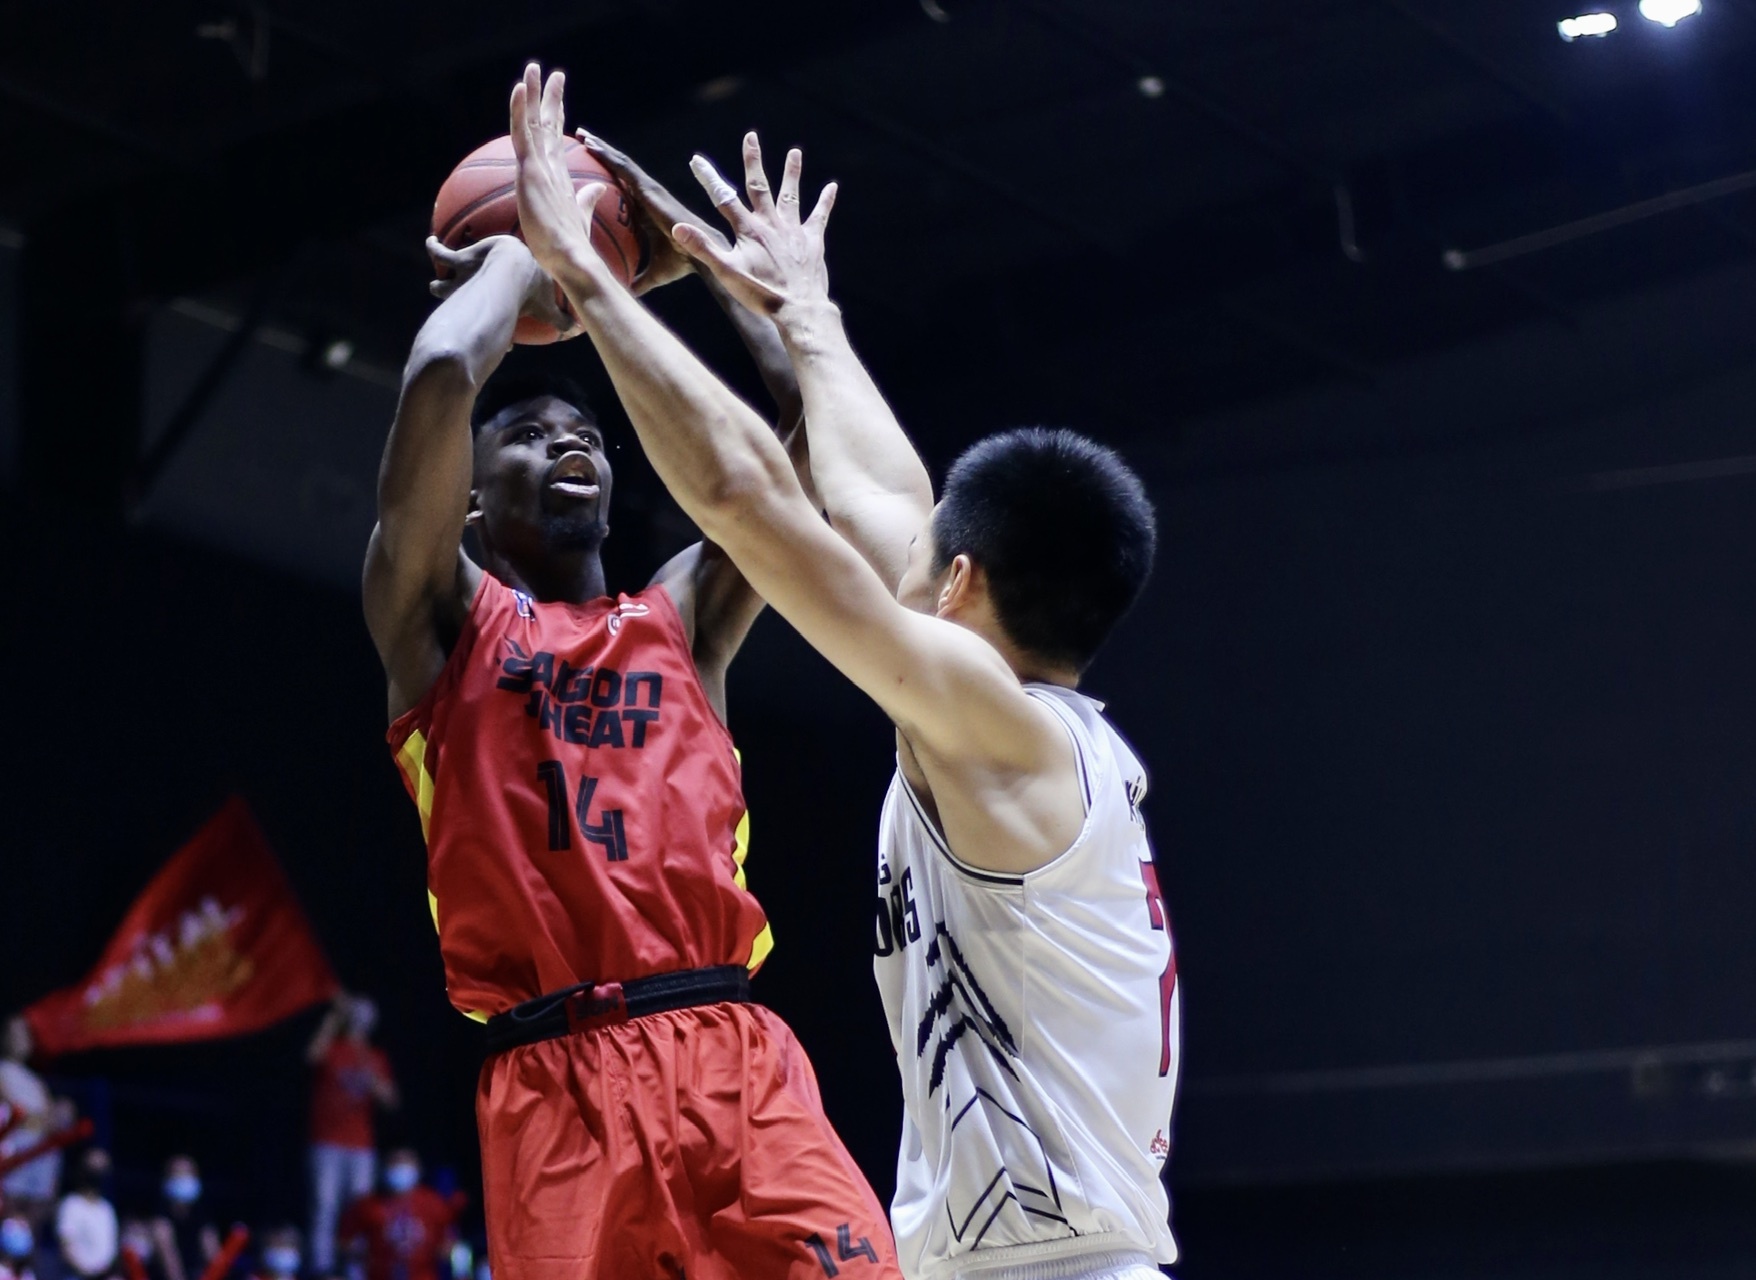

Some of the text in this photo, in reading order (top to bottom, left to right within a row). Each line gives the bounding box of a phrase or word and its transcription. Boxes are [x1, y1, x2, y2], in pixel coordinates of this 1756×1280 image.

[496, 648, 662, 708] SAIGON
[525, 690, 660, 748] HEAT
[537, 759, 629, 862] 14
[805, 1221, 879, 1279] 14
